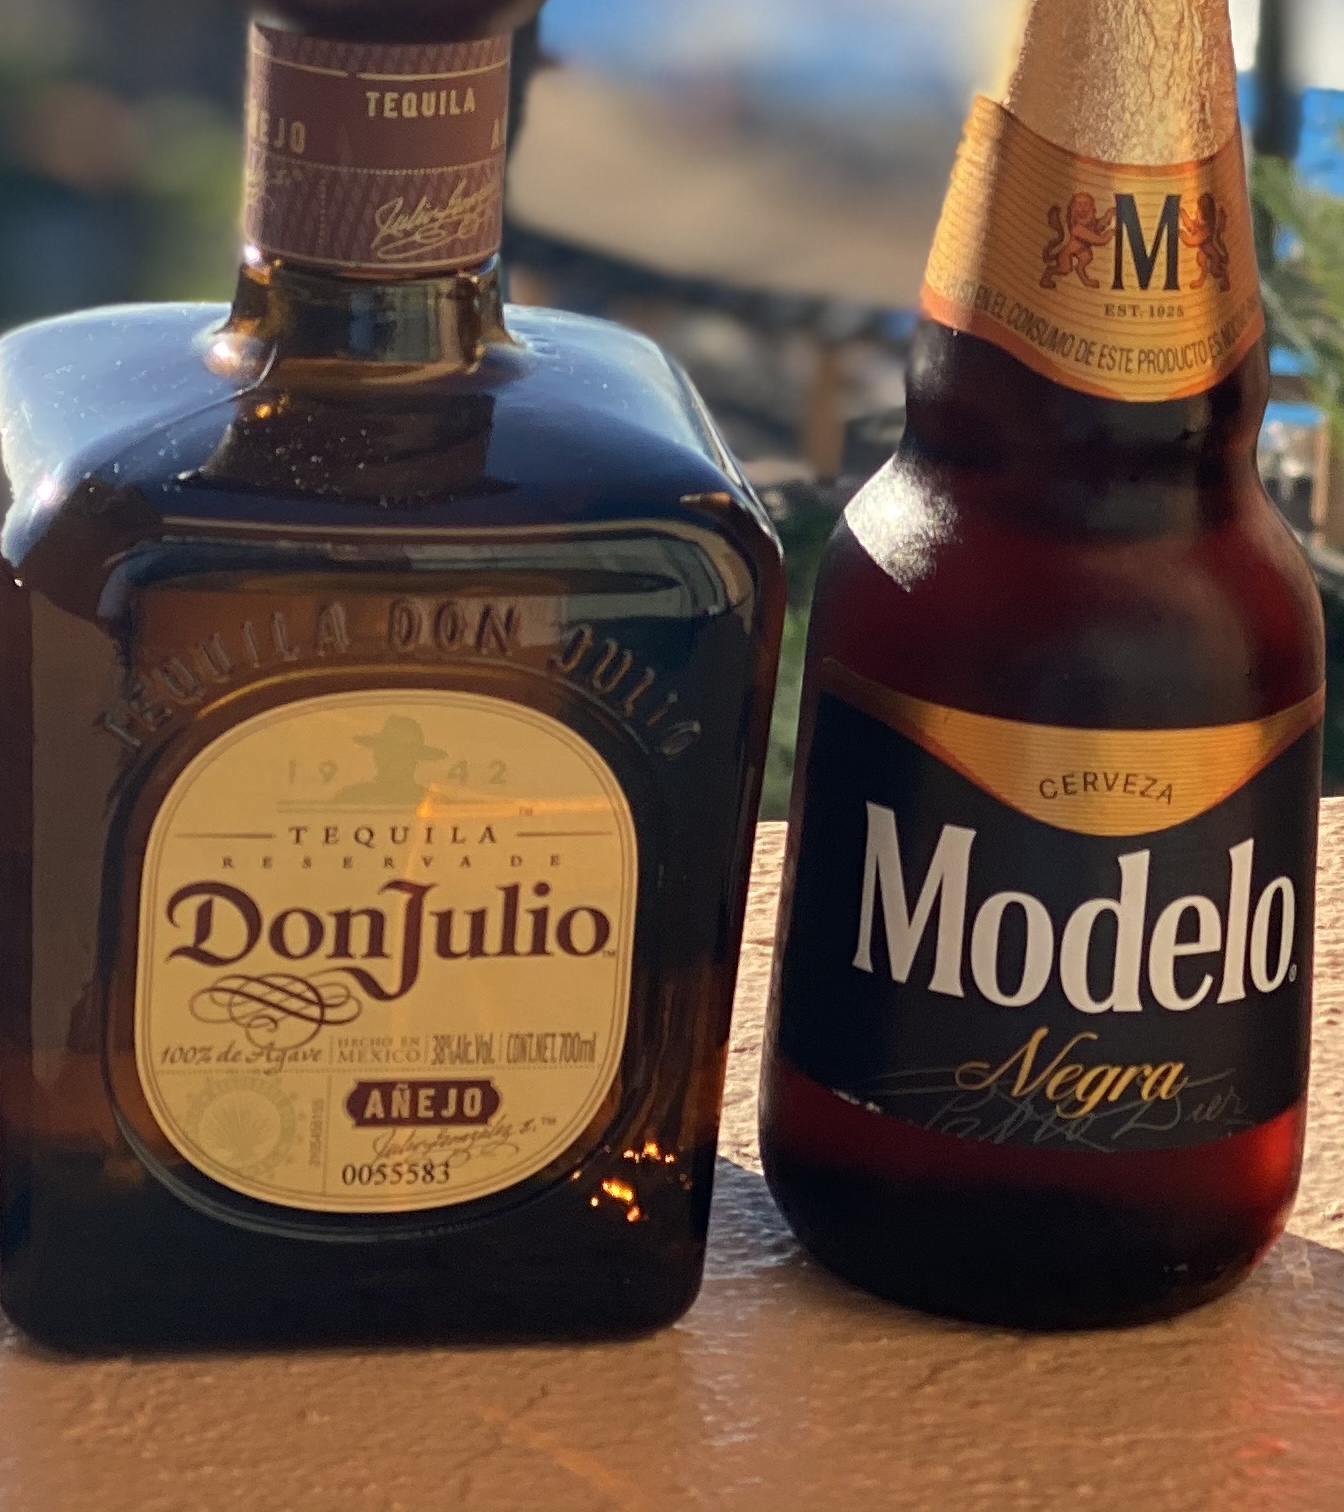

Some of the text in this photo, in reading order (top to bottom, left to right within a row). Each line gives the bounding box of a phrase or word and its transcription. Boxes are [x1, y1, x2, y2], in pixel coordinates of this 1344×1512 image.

[365, 87, 477, 118] TEQUILA
[1111, 192, 1182, 291] M
[1006, 301, 1076, 359] CONSUMO
[1074, 339, 1097, 366] DE
[1097, 343, 1134, 374] ESTE
[1137, 339, 1206, 375] PRODUCTO
[387, 598, 522, 657] DON
[1038, 770, 1174, 805] CERVEZA
[288, 824, 498, 849] TEQUILA
[221, 853, 562, 870] RESERVA DE
[852, 799, 1296, 1014] Modelo
[215, 1039, 243, 1064] de
[955, 1024, 1190, 1120] Negra
[363, 1083, 483, 1120] AÑEJO
[342, 1161, 450, 1186] 0055583
